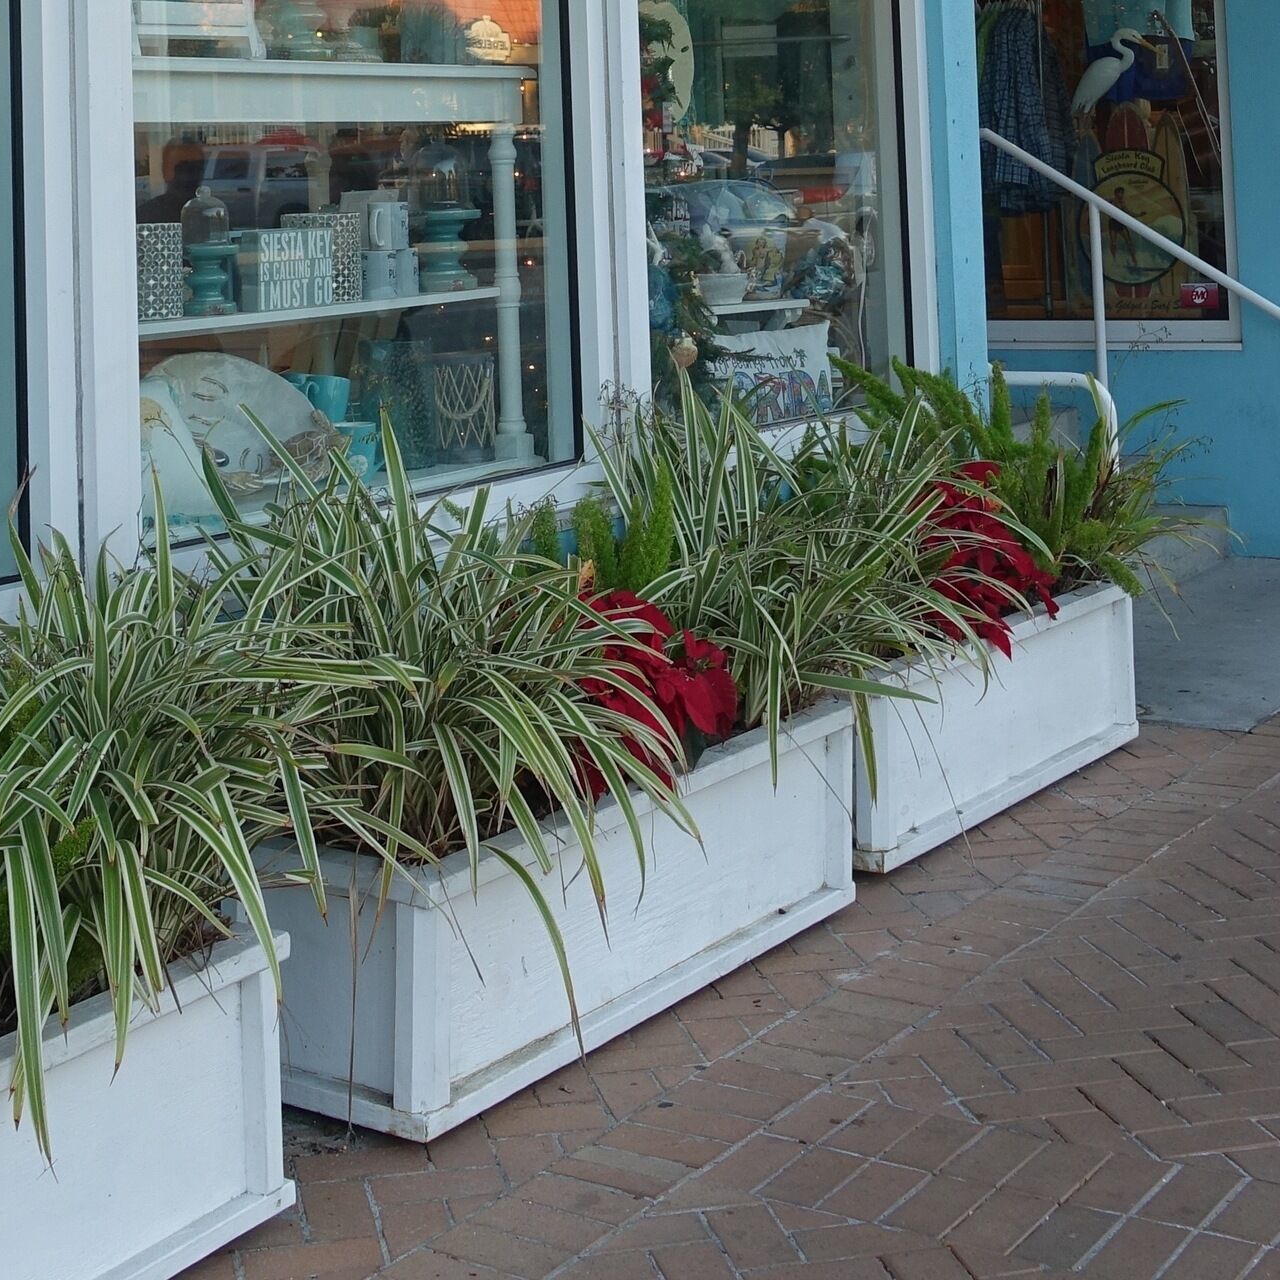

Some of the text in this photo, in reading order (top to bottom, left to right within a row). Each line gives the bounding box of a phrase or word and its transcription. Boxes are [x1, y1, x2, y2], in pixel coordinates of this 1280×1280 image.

[1134, 152, 1151, 164] Key
[260, 230, 332, 262] SIESTA KEY
[260, 257, 332, 282] IS CALLING AND
[261, 276, 333, 311] I MUST GO
